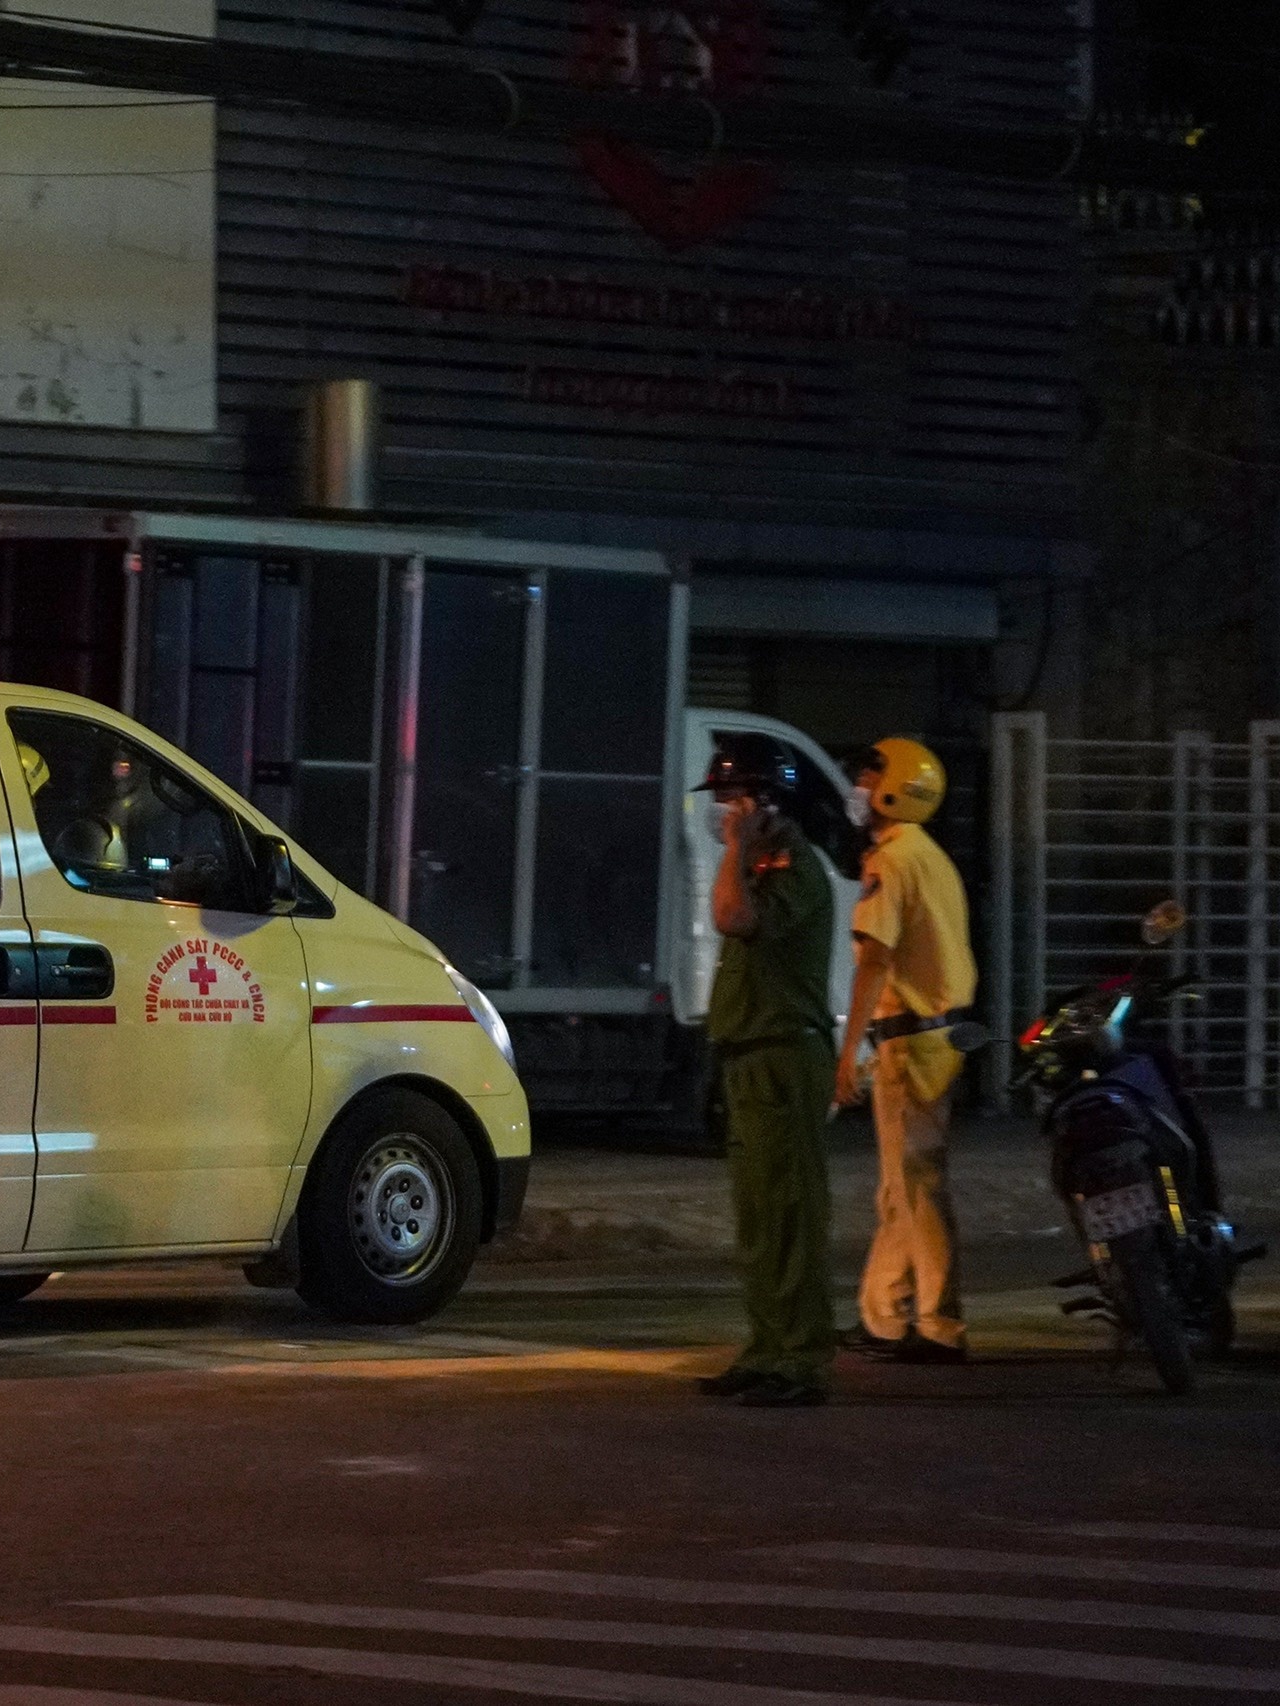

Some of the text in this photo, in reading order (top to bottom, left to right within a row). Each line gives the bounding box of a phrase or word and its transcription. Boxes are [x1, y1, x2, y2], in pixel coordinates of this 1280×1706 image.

[186, 938, 208, 954] SÁT
[213, 942, 244, 971] PCCC
[242, 971, 252, 982] &
[249, 983, 265, 1022] CNCH
